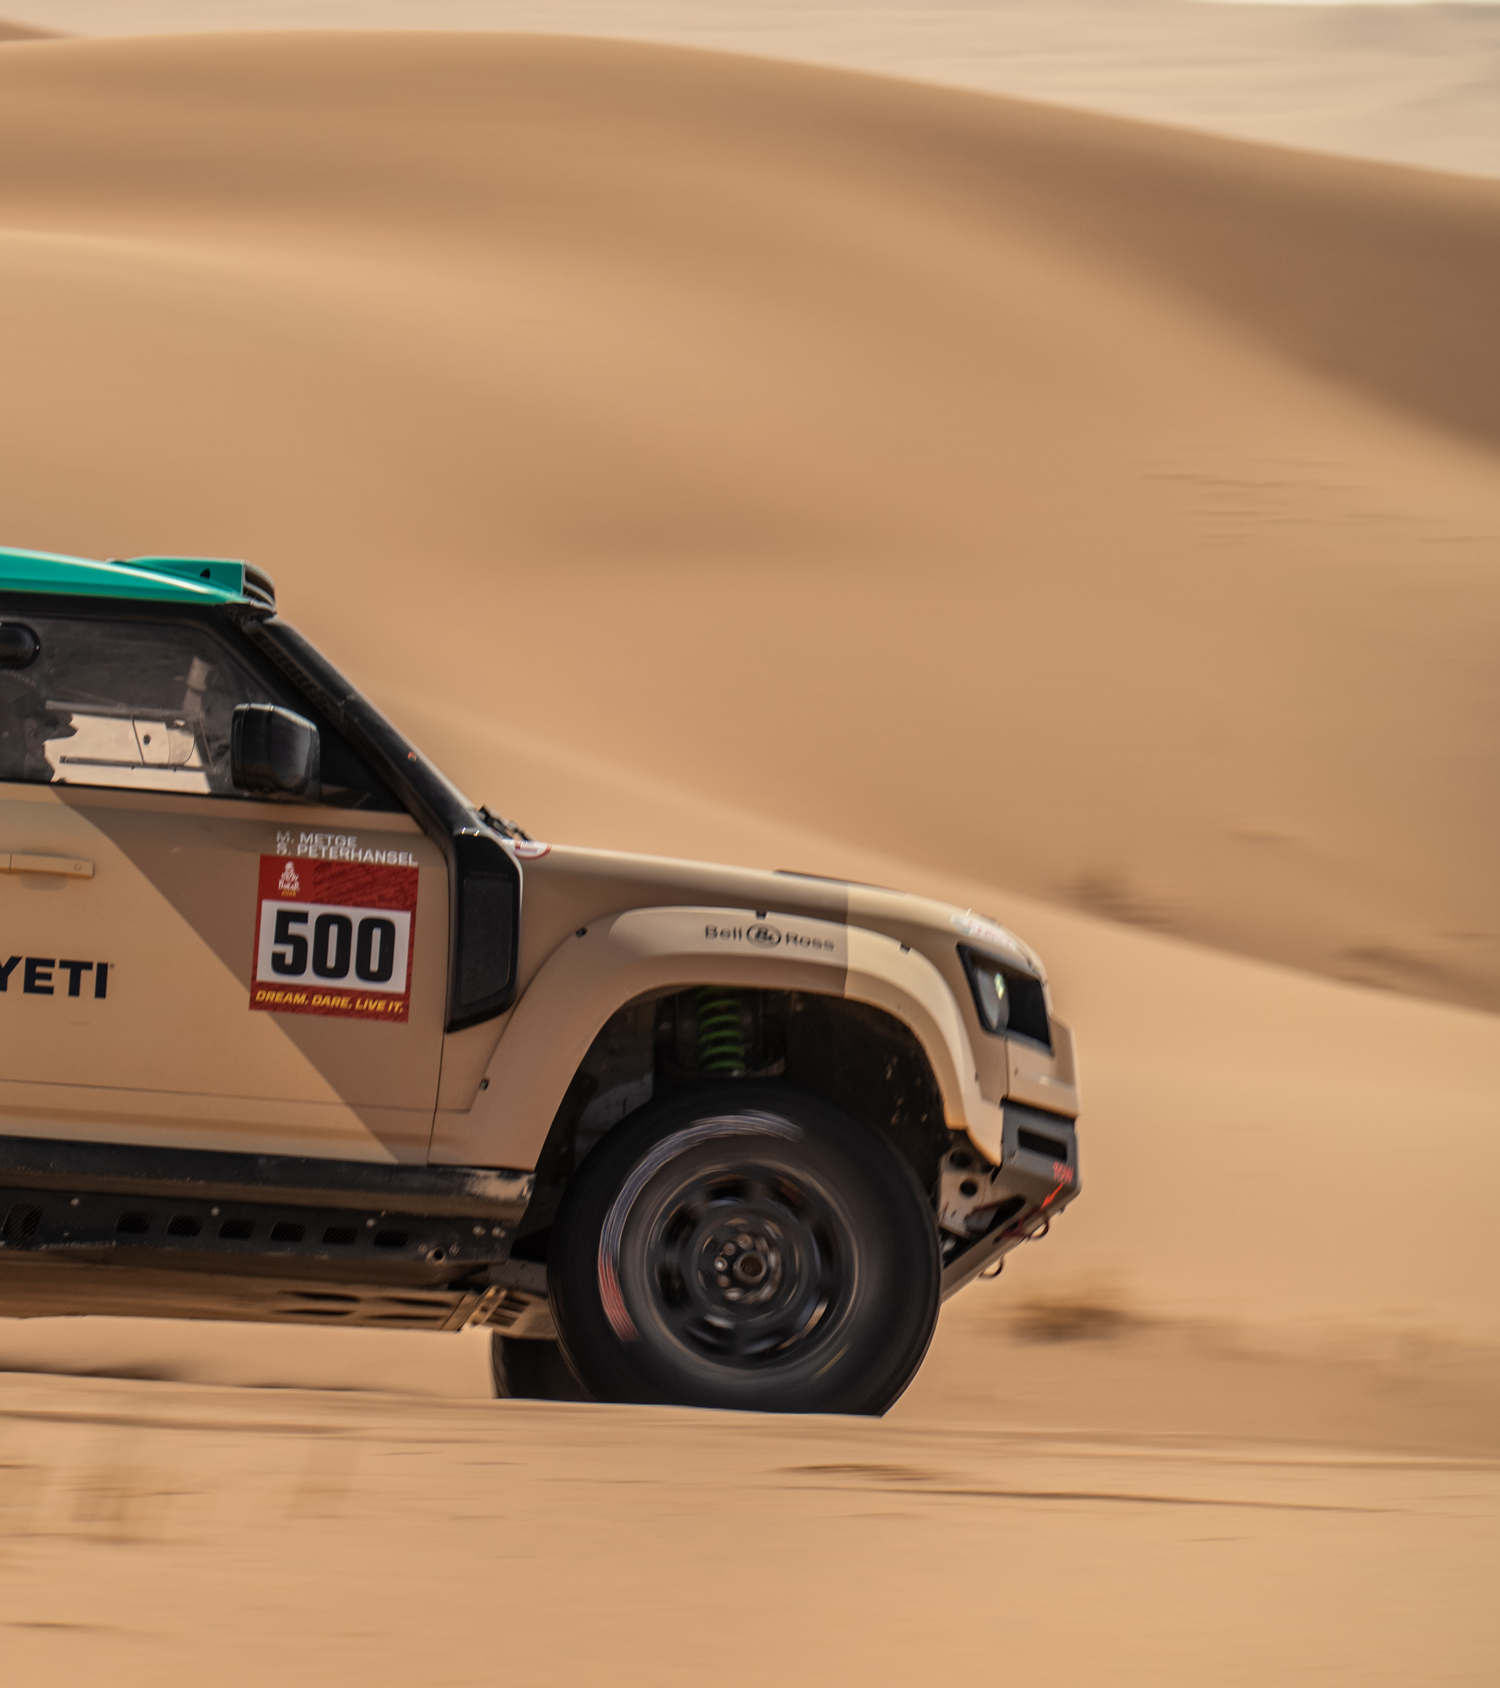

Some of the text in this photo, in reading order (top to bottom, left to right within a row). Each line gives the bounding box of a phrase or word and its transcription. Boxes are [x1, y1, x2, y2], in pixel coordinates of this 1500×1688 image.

[300, 832, 357, 848] METGE
[297, 842, 419, 867] PETERHANSEL
[271, 908, 396, 983] 500
[705, 925, 742, 940] Bell
[786, 931, 835, 952] Ross
[255, 989, 403, 1014] DREAM. DARE. LIVE IT.
